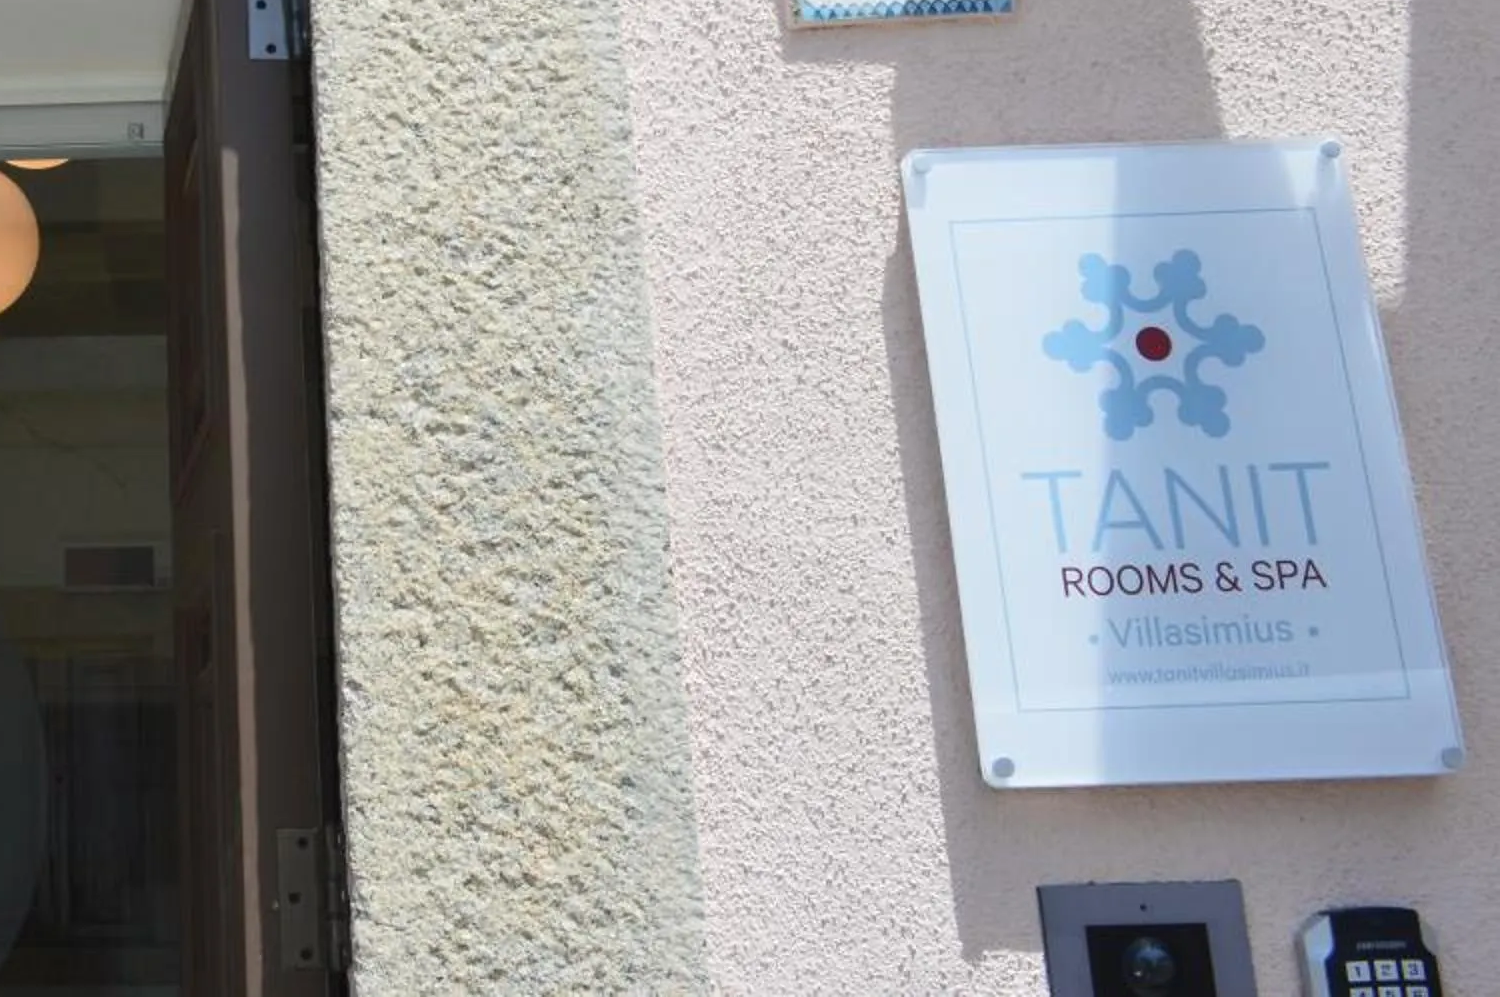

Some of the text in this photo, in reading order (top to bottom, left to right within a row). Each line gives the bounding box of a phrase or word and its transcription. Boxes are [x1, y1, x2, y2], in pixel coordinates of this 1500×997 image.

[1020, 461, 1331, 554] TANIT
[1061, 558, 1329, 598] ROOMS & SPA
[1106, 613, 1296, 649] Villasimius
